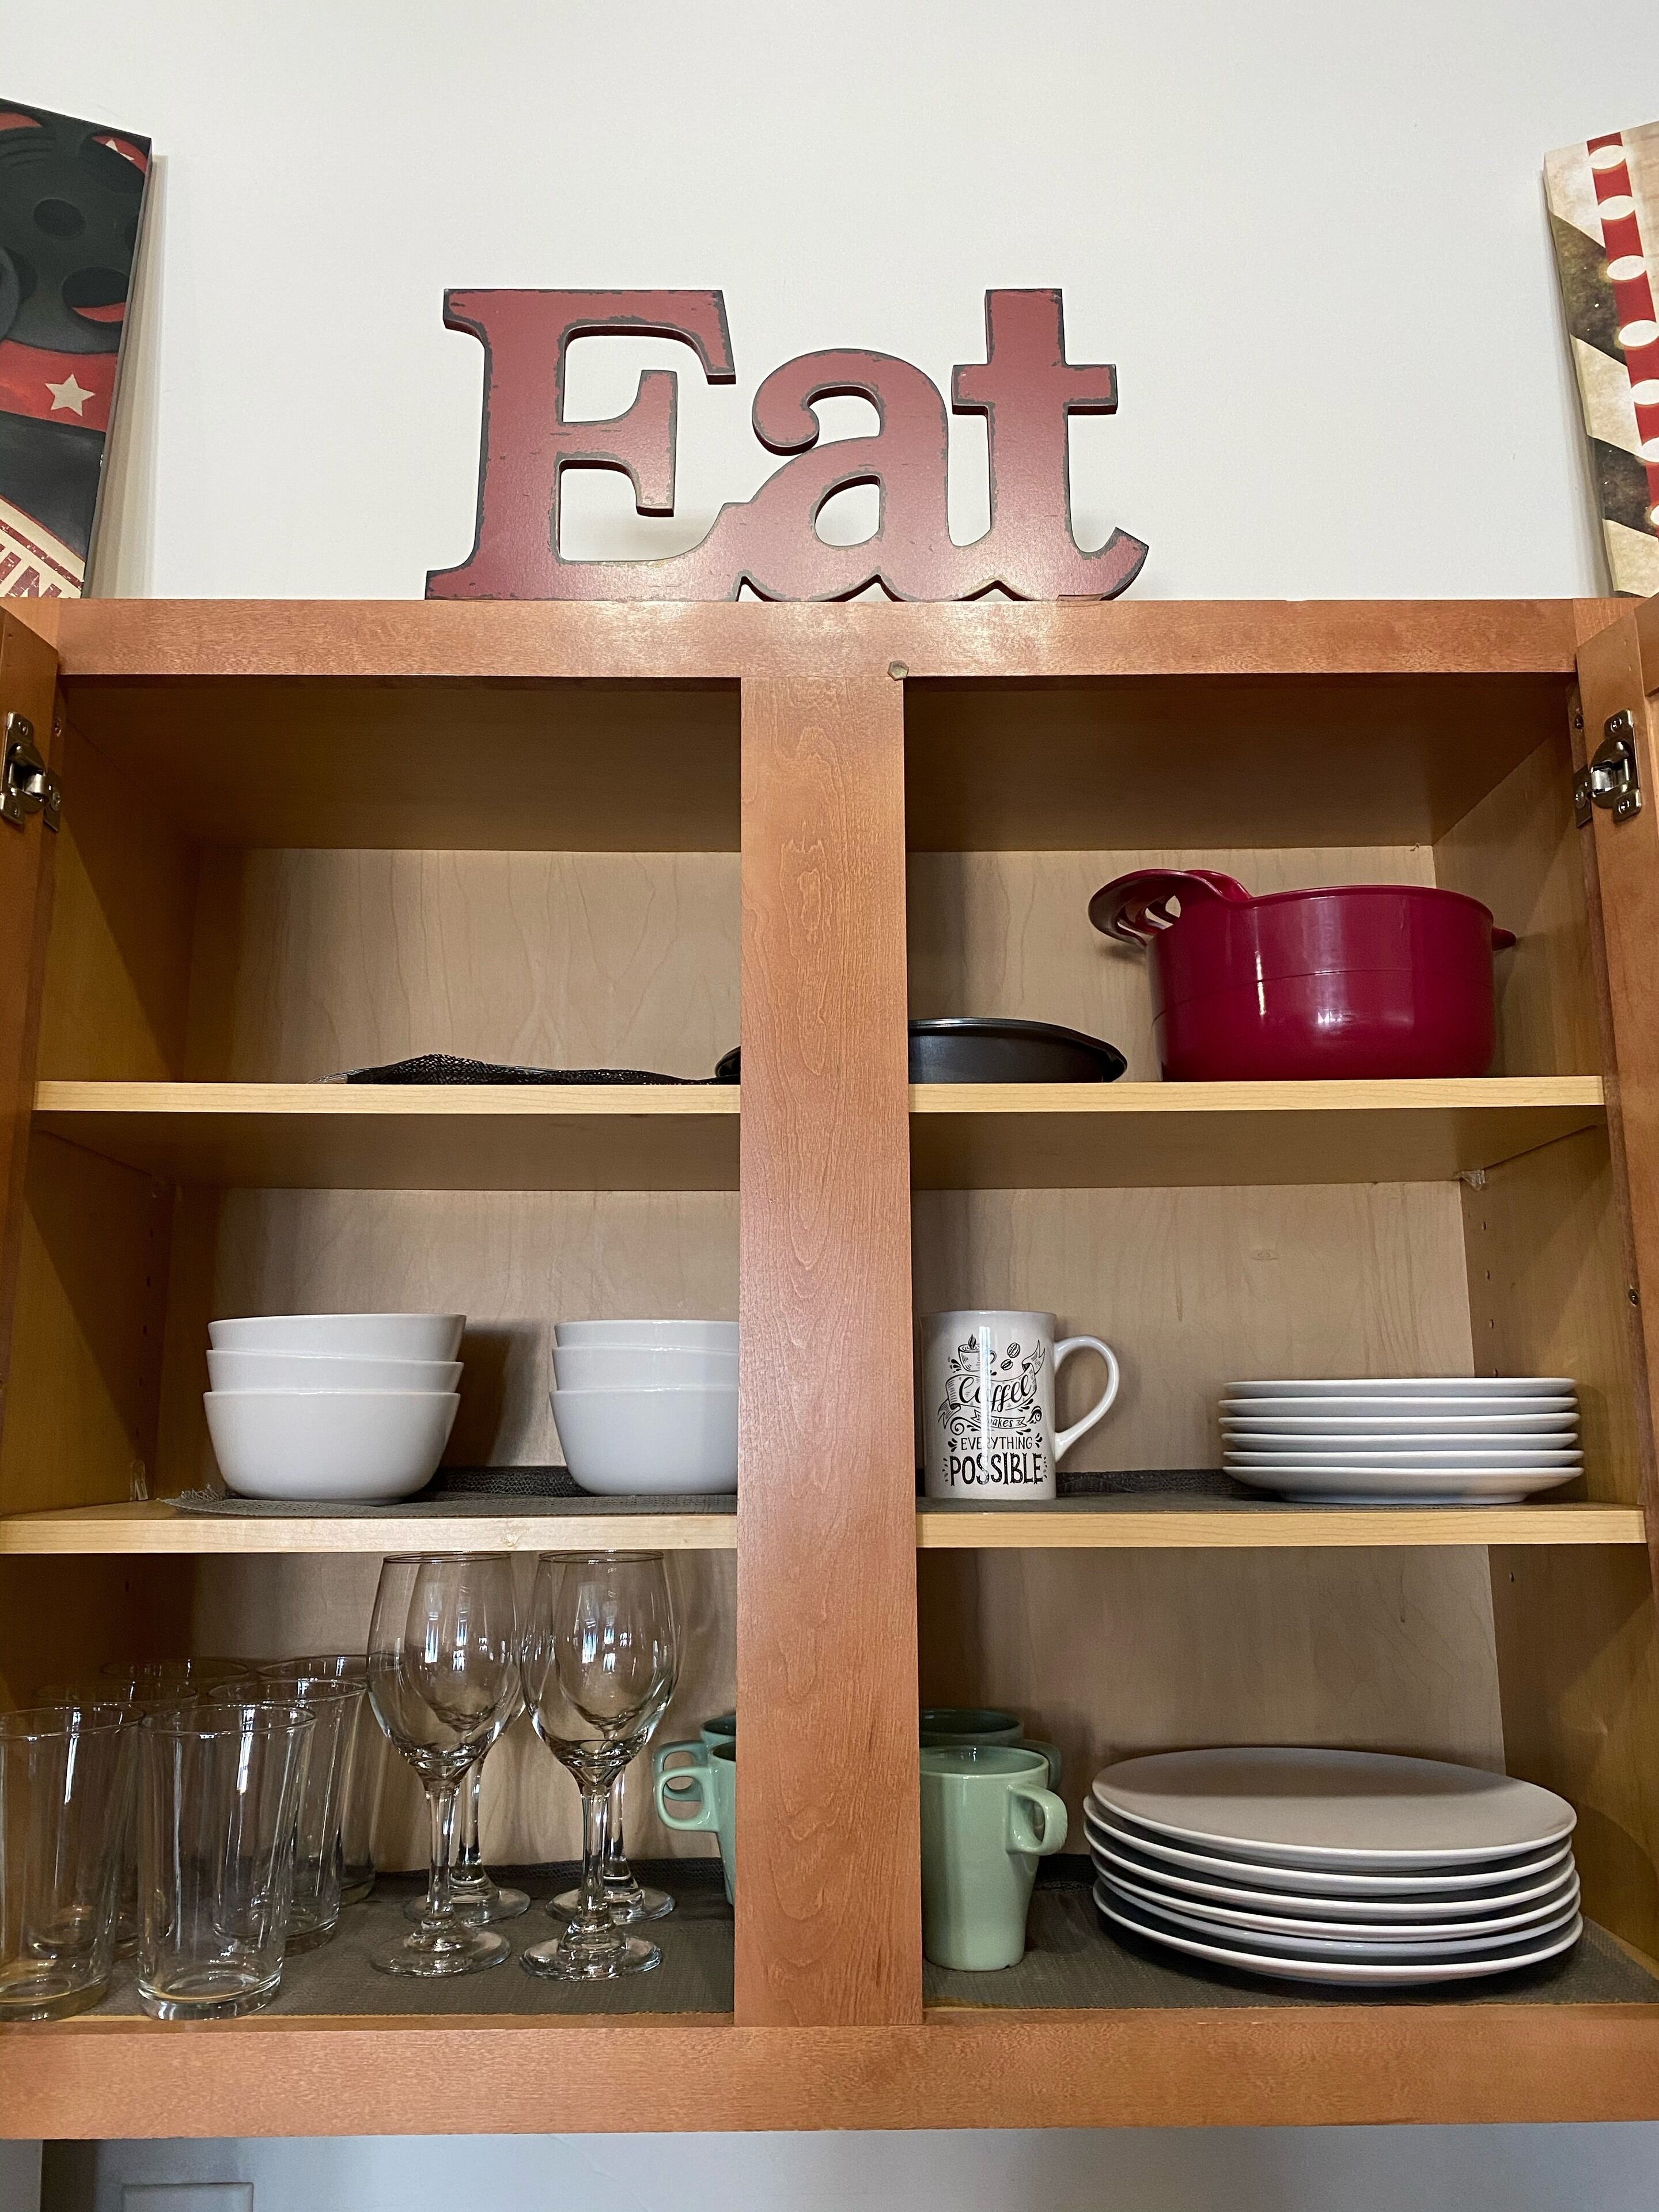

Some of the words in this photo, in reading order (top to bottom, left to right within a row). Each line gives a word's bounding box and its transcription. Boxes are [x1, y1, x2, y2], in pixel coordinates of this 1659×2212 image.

[425, 288, 1149, 602] Eat
[983, 1419, 1014, 1428] akes
[949, 1452, 1043, 1487] POSSIBLE
